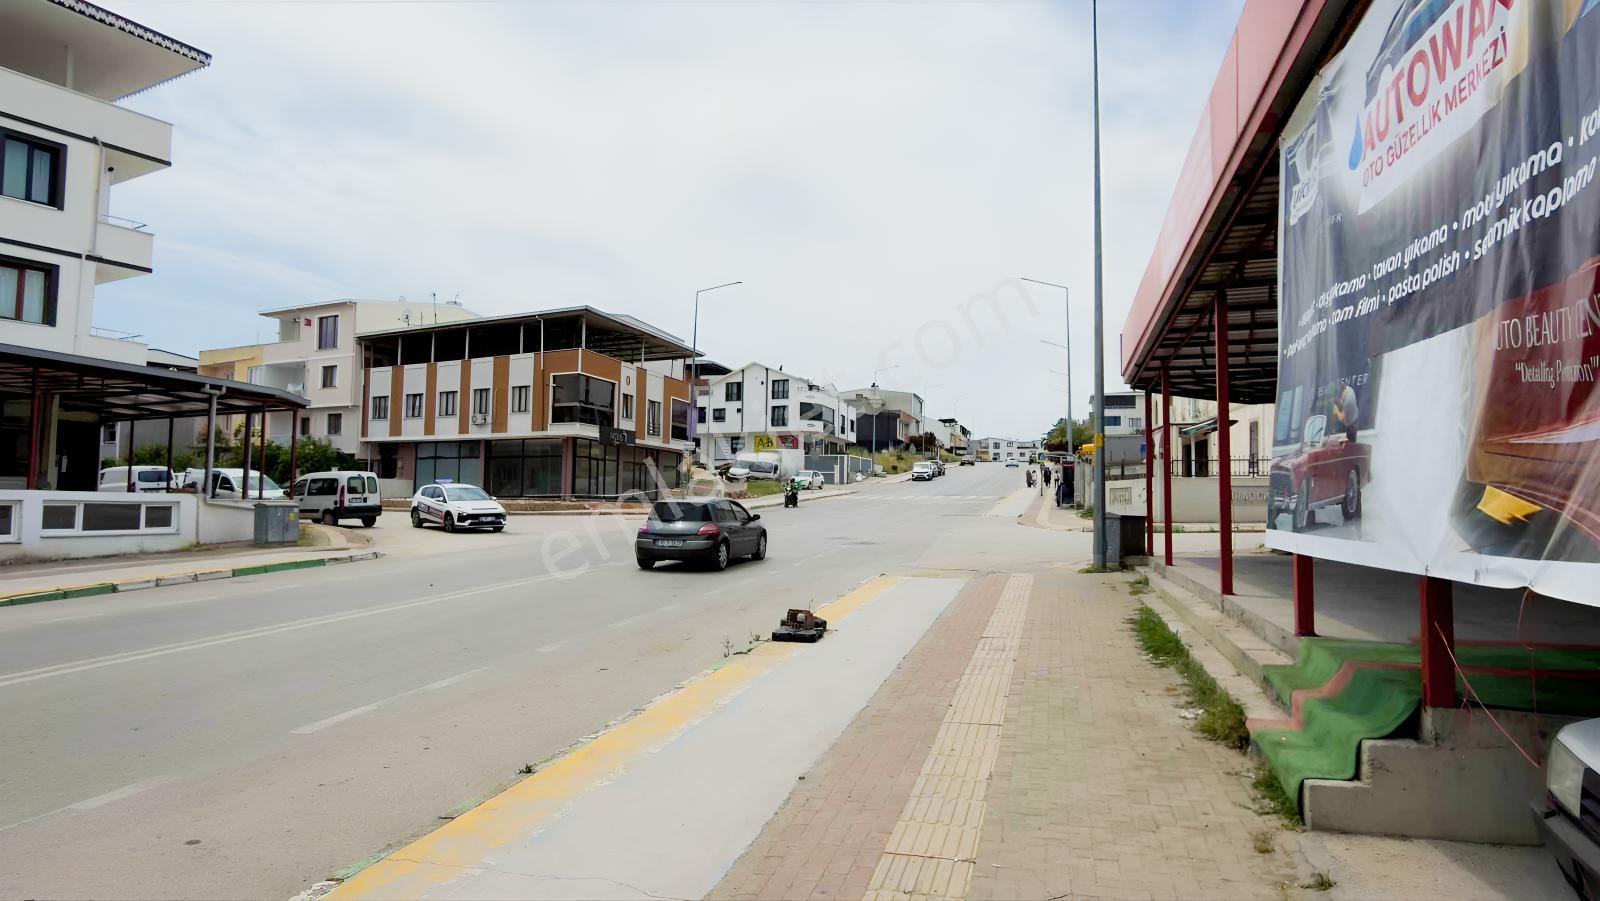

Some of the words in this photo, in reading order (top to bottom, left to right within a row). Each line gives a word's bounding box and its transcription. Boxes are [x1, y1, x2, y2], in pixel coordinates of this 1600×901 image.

[1362, 156, 1383, 188] OTO
[1386, 100, 1442, 168] GÜZELLİK
[1444, 26, 1508, 116] MERKEZİ
[1355, 289, 1381, 318] filmi
[1388, 273, 1421, 306] pasta
[1422, 250, 1460, 290] polish
[1522, 157, 1597, 225] kaplama
[1373, 252, 1402, 281] tavan
[1404, 225, 1448, 269] yıkama
[1496, 141, 1563, 208] yıkama
[1525, 307, 1573, 348] BEAUTY
